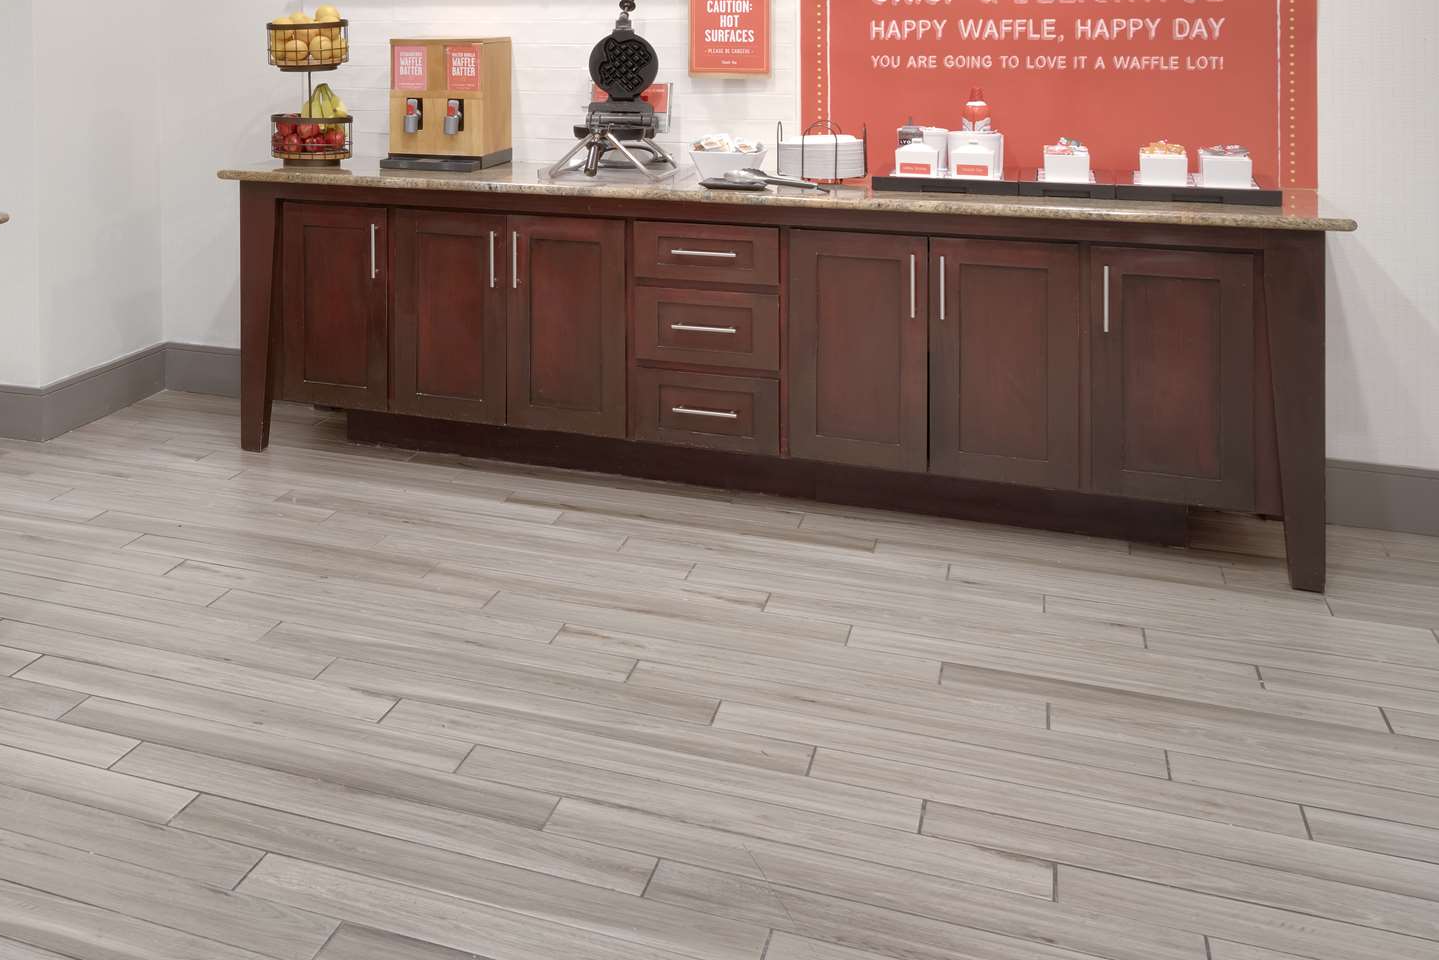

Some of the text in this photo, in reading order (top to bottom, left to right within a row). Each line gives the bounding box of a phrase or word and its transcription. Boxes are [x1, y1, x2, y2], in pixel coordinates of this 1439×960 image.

[706, 0, 753, 14] CAUTION:
[720, 14, 740, 28] HOT
[704, 28, 755, 43] SURFACES
[870, 17, 1226, 43] HAPPY WAFFLE, HAPPY DAY
[400, 56, 423, 66] WAFFLE
[452, 57, 476, 67] WAFFLE
[871, 55, 1224, 70] YOU ARE GOING TO LOVE IT A WAFFLE LOT!
[400, 66, 423, 76] BATTER
[452, 67, 476, 77] BATTER
